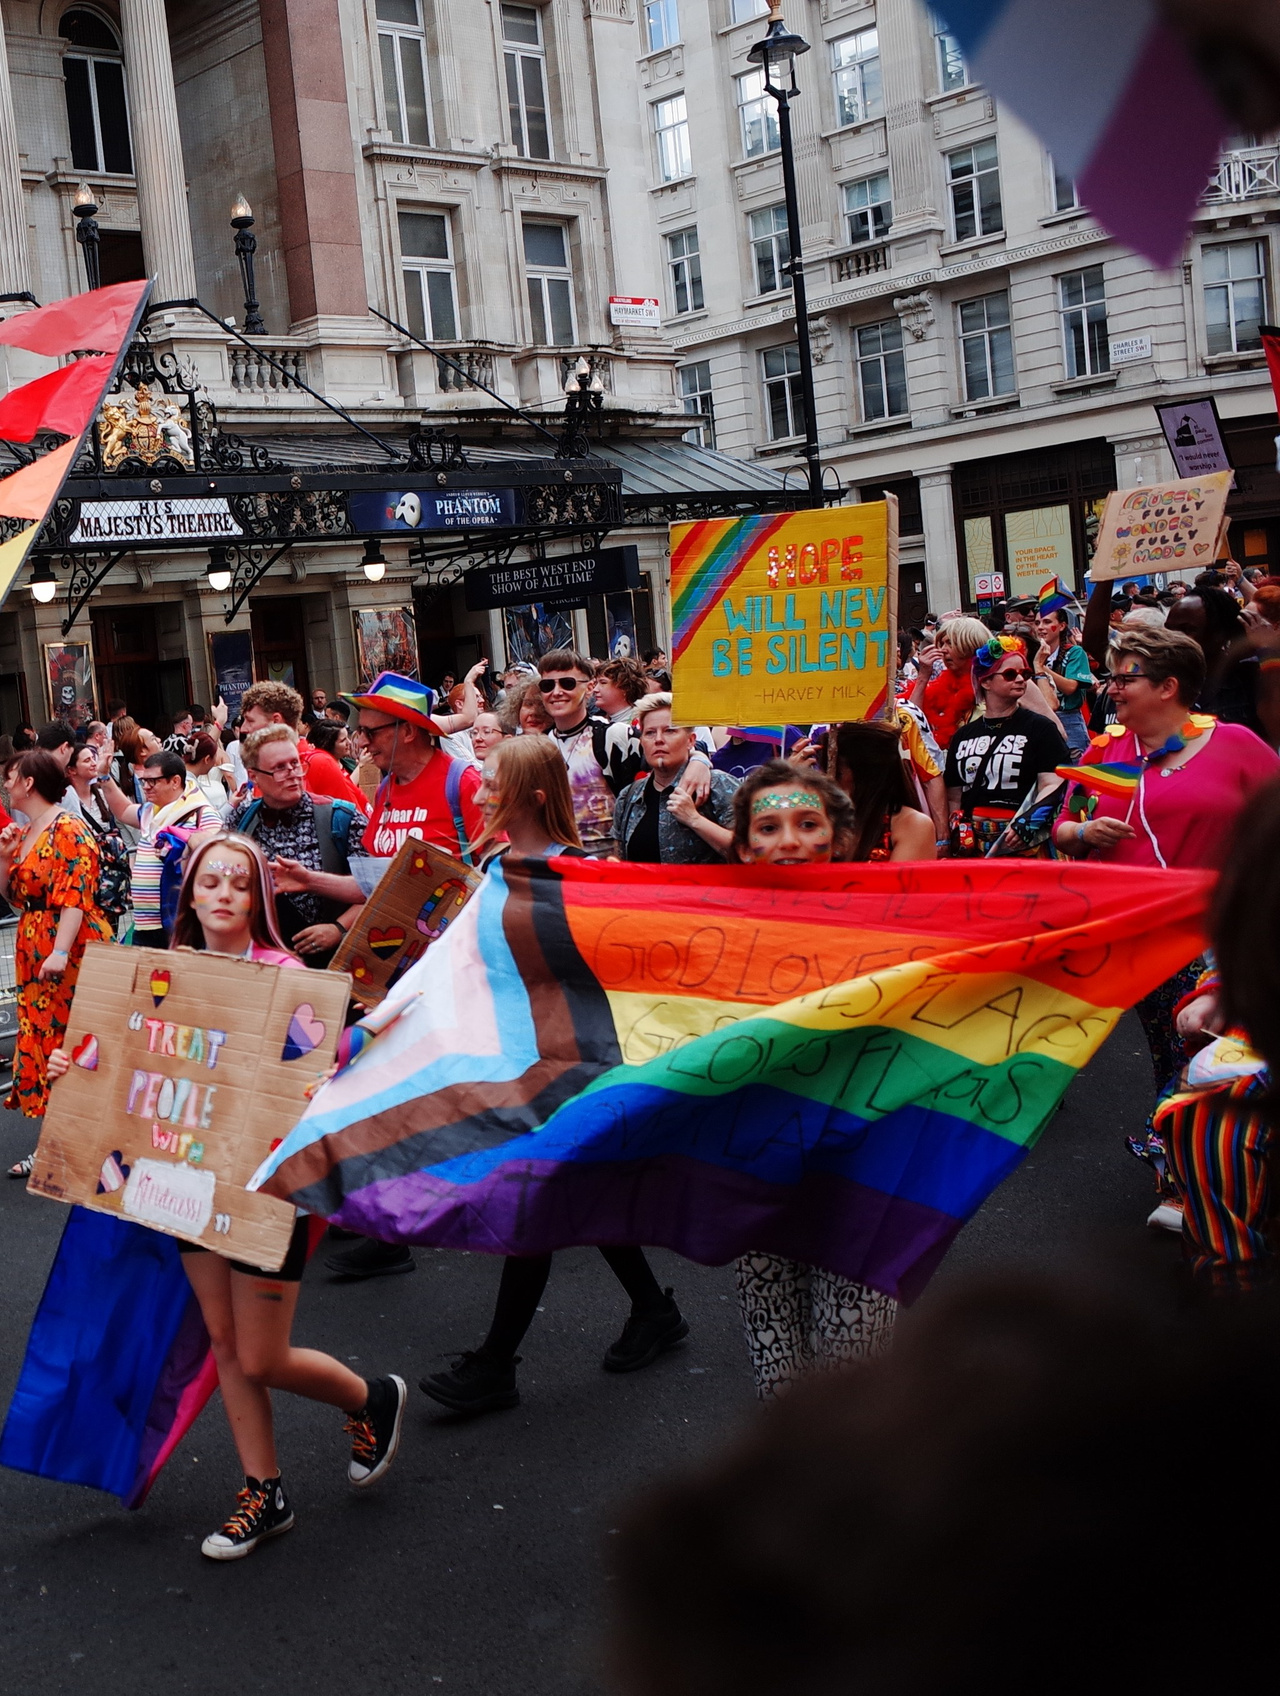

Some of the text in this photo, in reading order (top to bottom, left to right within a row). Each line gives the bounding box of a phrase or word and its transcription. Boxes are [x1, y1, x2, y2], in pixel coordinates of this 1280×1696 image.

[1113, 339, 1138, 350] CHARLES
[1113, 347, 1134, 356] STREET
[139, 502, 172, 515] HIS
[435, 498, 501, 516] PHANTOM
[1142, 500, 1205, 520] FULLY
[167, 512, 233, 534] THEATRE
[445, 517, 494, 526] OF THE OPERA
[1136, 529, 1198, 549] FULLY
[1014, 545, 1056, 557] YOUR SPACE
[1037, 552, 1059, 561] HEART
[1132, 542, 1187, 564] MADE
[489, 558, 596, 585] THE BEST WEST END
[766, 535, 864, 589] HOPE
[491, 580, 522, 595] SHOW
[525, 579, 539, 590] OF
[541, 575, 562, 588] ALL
[723, 593, 807, 635] WILL
[712, 630, 889, 677] BE SILENT
[831, 684, 867, 700] MILK
[594, 914, 726, 988] GOD
[126, 1069, 218, 1130] PEOPLE
